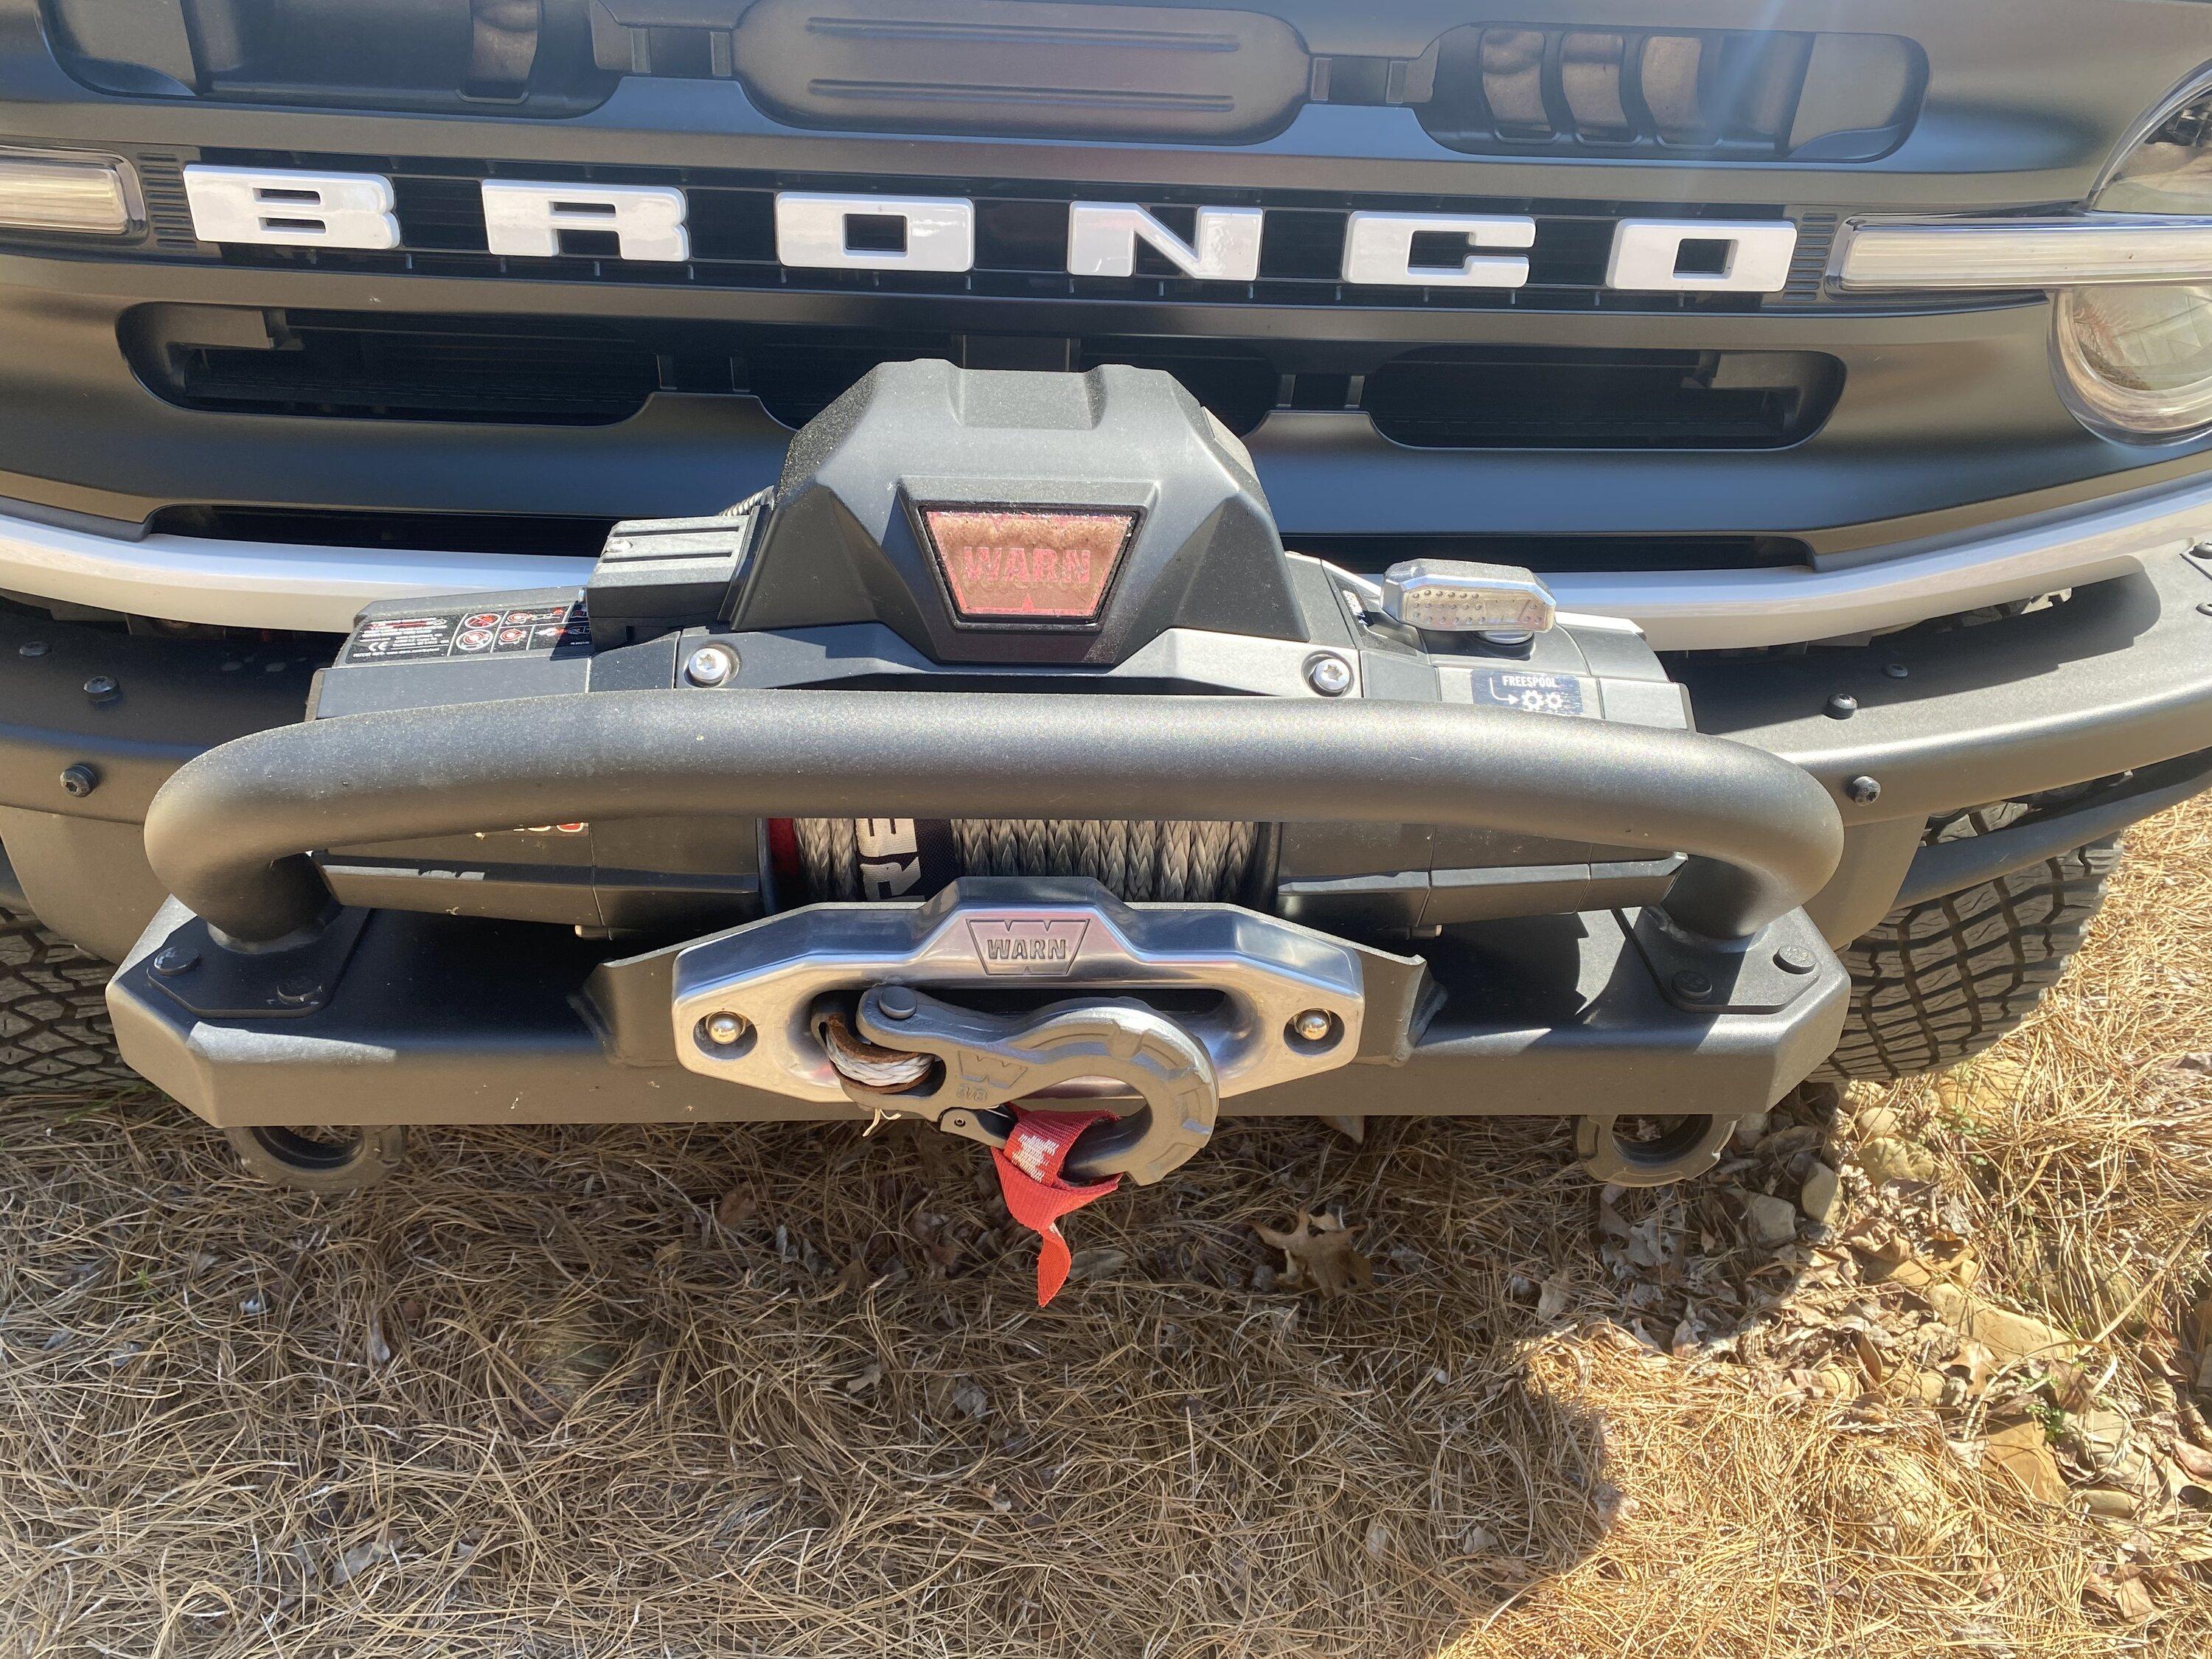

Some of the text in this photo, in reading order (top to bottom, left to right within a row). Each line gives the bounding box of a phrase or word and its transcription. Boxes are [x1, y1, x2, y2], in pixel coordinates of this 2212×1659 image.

[183, 164, 1798, 293] BRONCO
[962, 546, 1091, 584] WARN
[1502, 675, 1559, 688] FREESPOOL
[987, 939, 1066, 959] WARN
